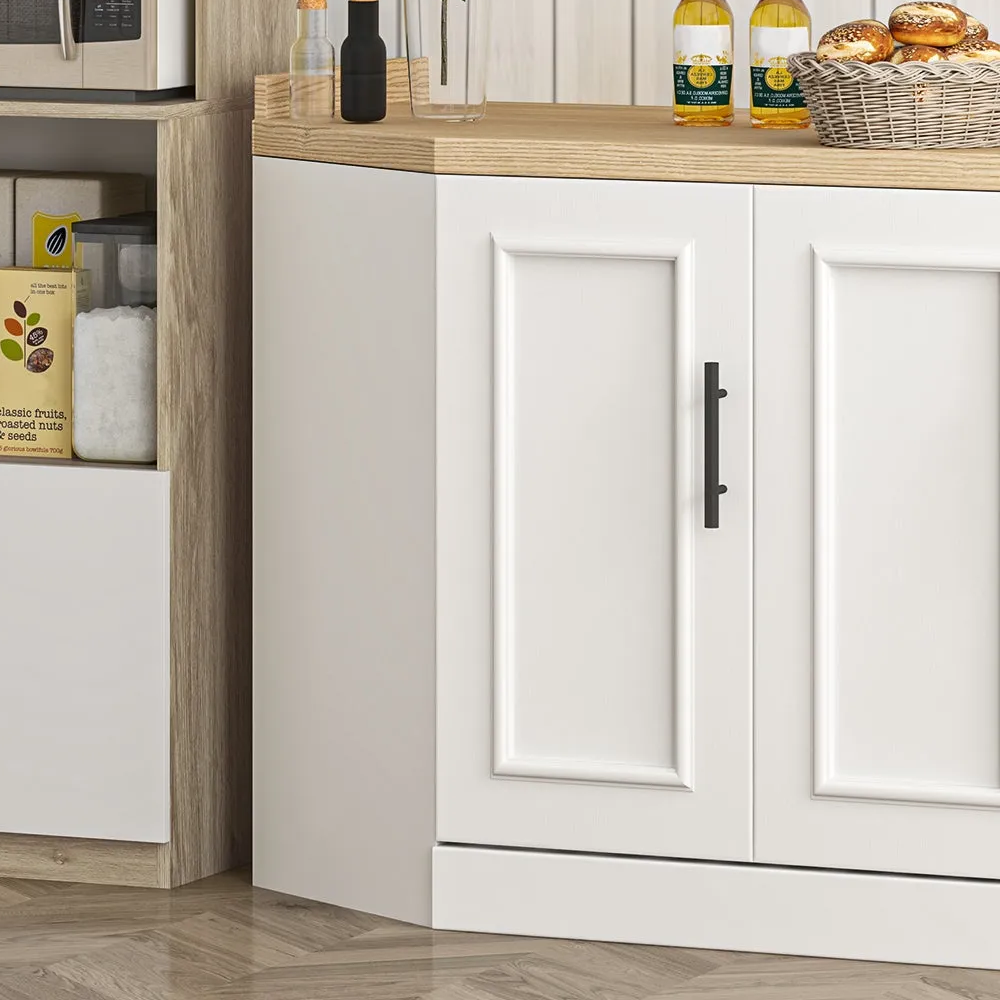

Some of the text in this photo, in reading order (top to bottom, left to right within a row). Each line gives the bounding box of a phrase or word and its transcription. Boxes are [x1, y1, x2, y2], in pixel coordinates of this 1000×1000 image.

[34, 408, 67, 420] fruits,
[38, 422, 64, 431] nuts
[7, 431, 37, 441] seeds
